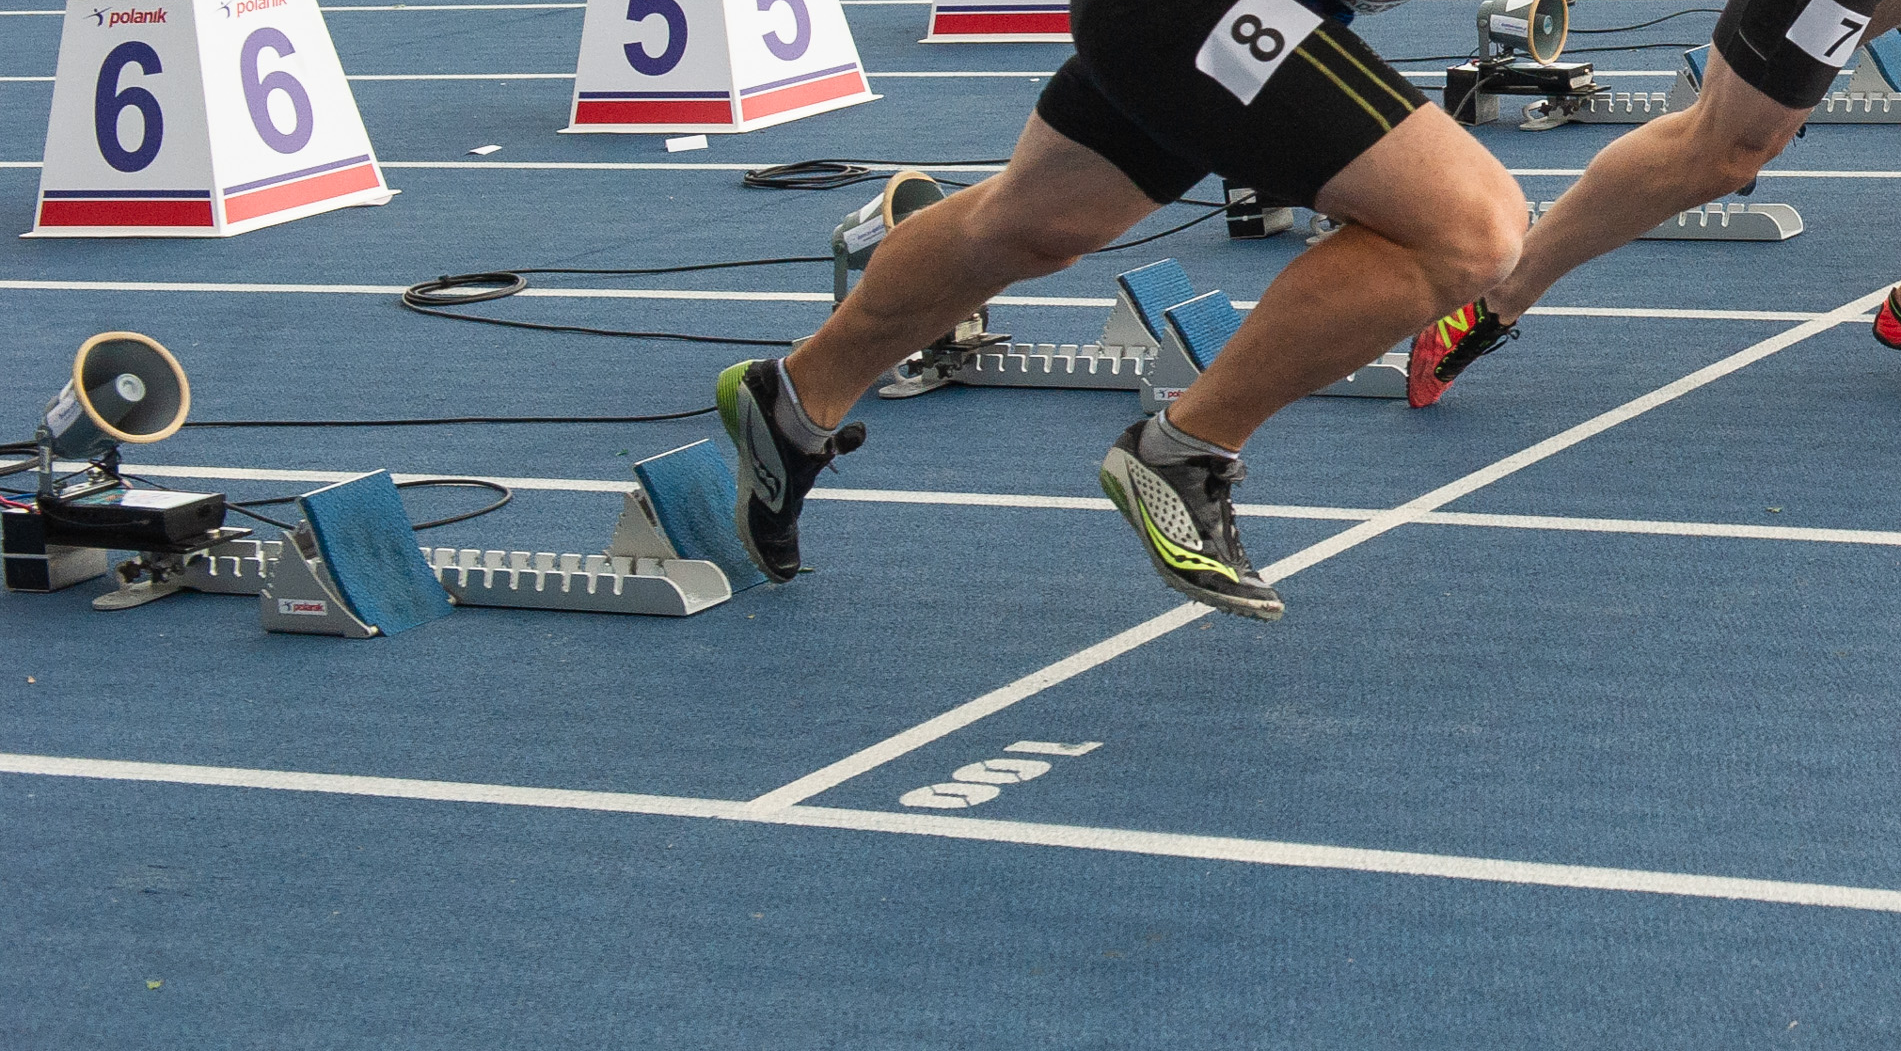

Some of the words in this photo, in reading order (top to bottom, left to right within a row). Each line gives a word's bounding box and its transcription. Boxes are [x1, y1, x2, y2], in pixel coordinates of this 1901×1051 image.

[108, 6, 168, 28] polanik
[1230, 13, 1285, 63] 8
[1823, 17, 1865, 57] 7
[95, 40, 164, 174] 6
[239, 27, 314, 155] 6
